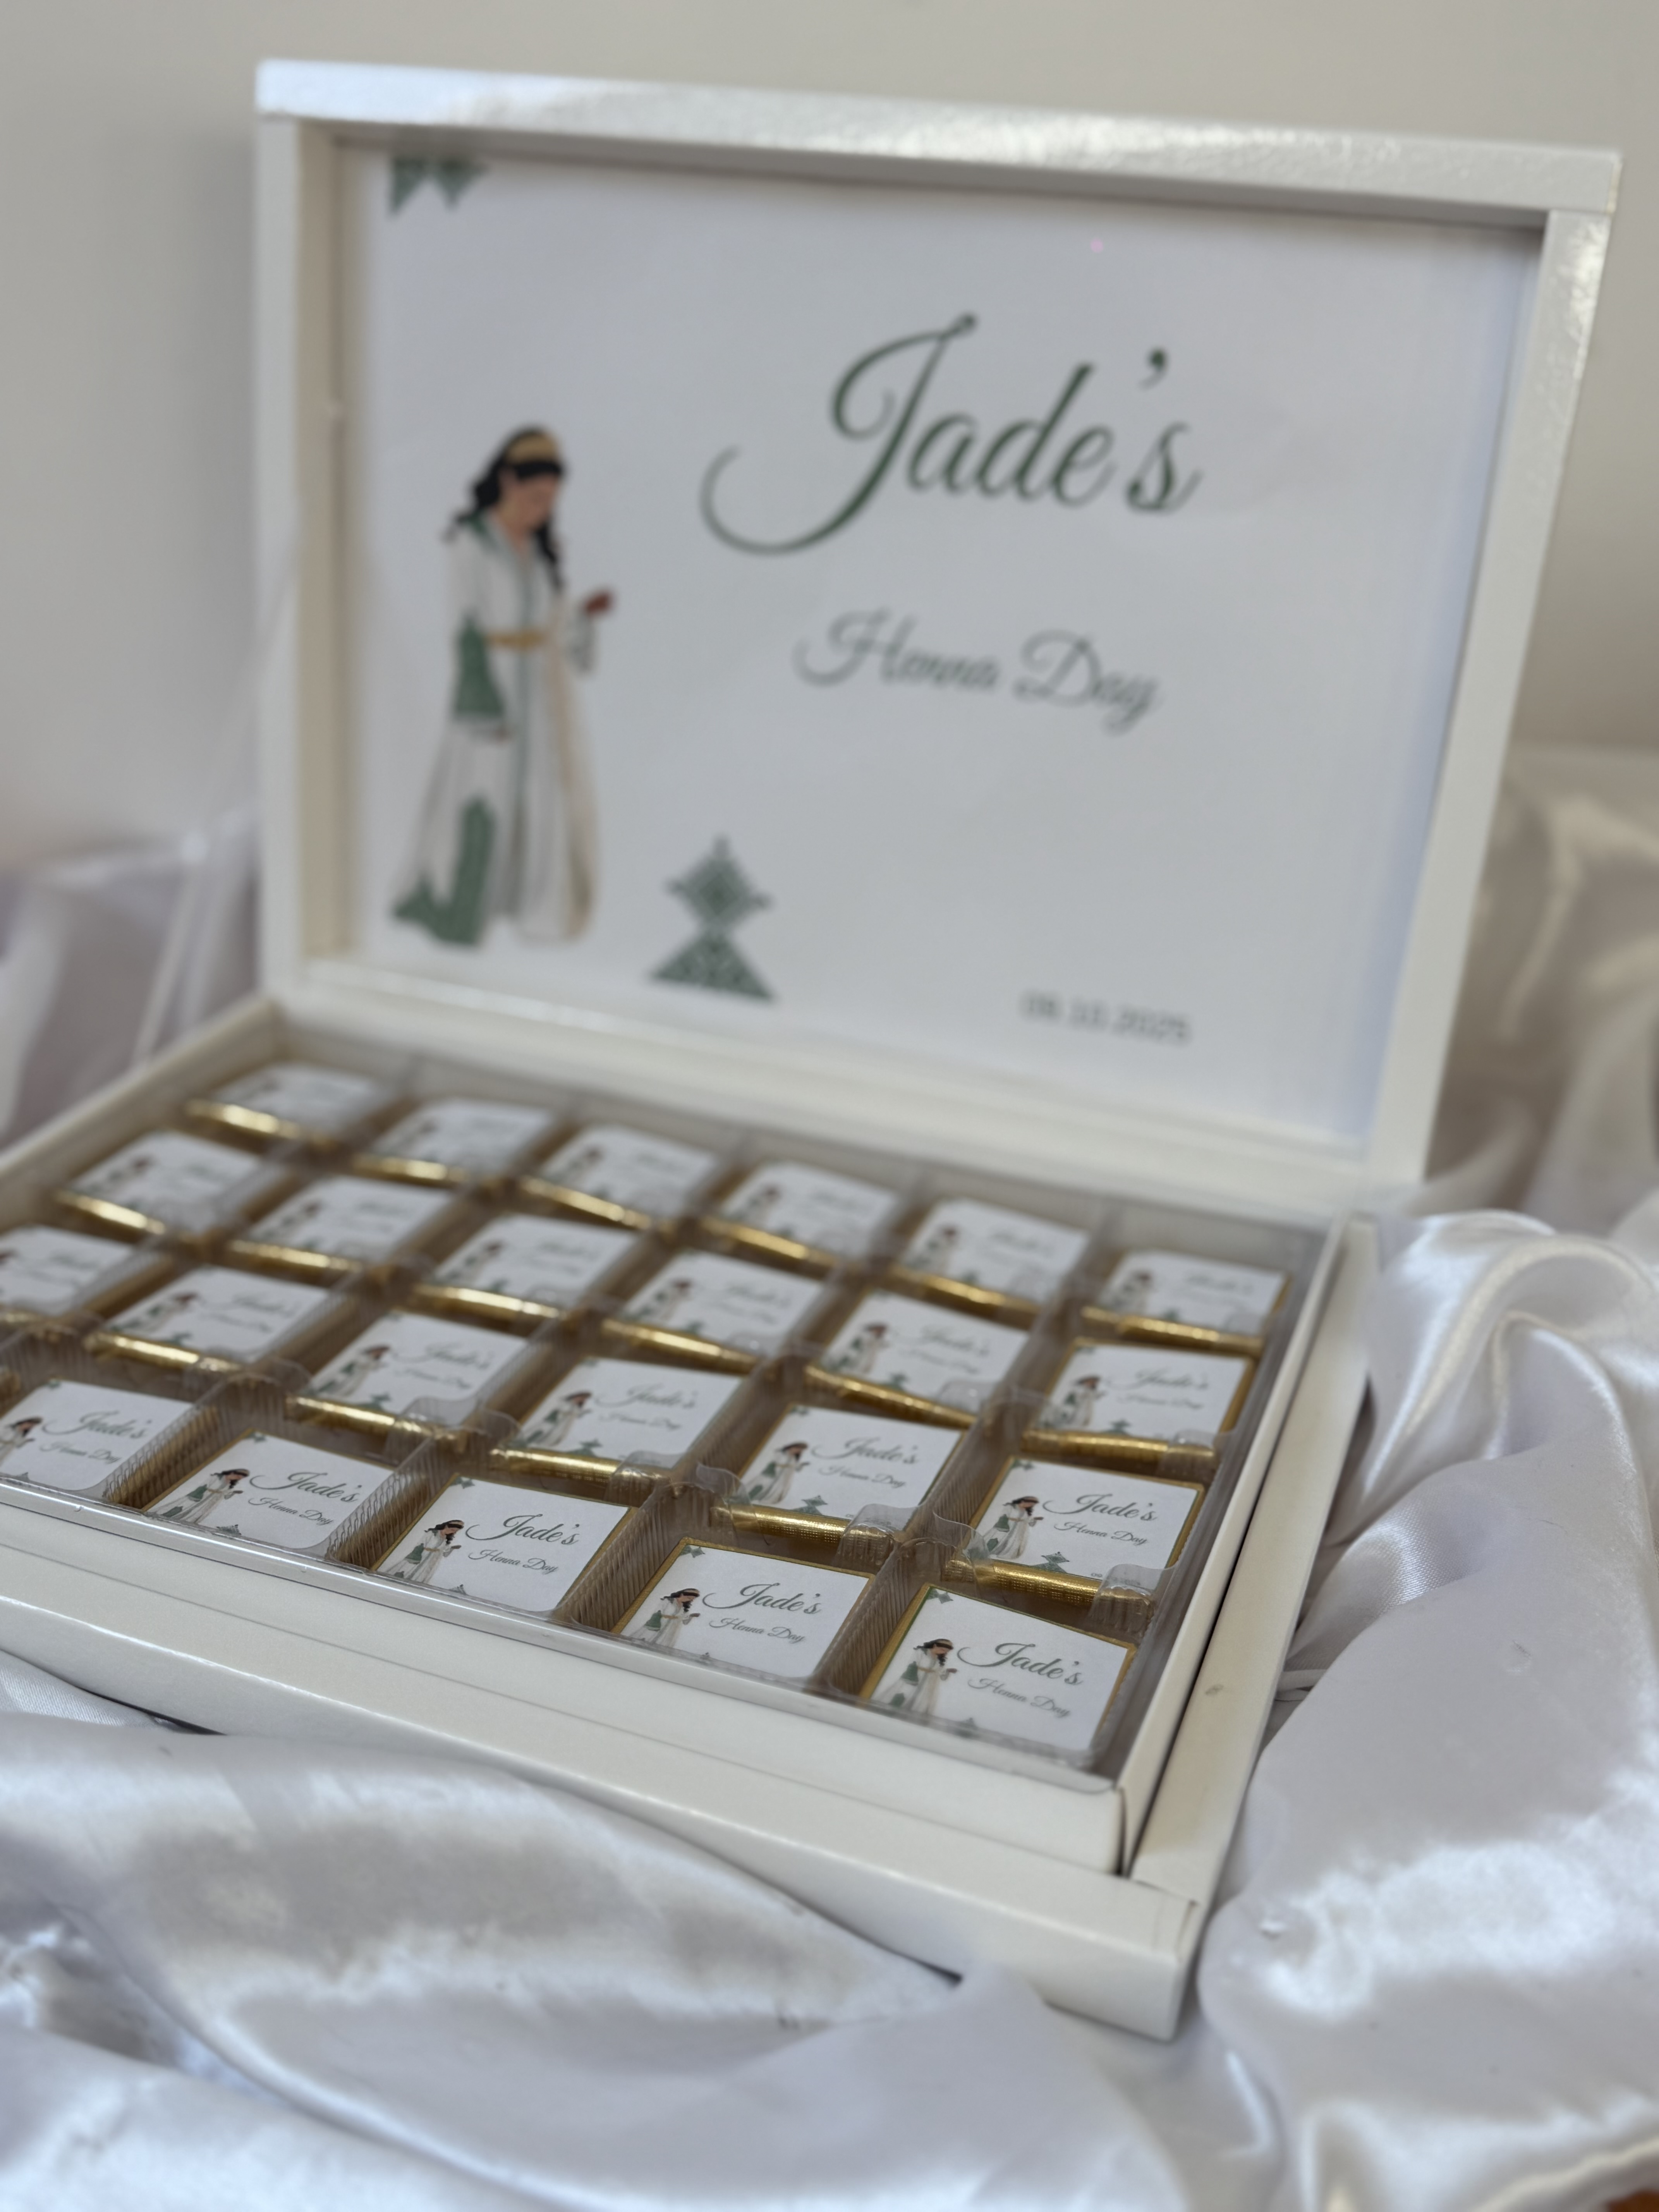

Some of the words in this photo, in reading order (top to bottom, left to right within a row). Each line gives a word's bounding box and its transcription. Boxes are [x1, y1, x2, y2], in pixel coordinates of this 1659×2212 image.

[699, 313, 1204, 557] Jade's
[1012, 627, 1161, 738] Day
[811, 1437, 920, 1464] Jade's
[249, 1471, 361, 1503] Jade's
[248, 1497, 298, 1515] Henna
[299, 1509, 335, 1526] Day
[1042, 1493, 1159, 1522] Jade's
[465, 1513, 582, 1546] Jade's
[1053, 1521, 1108, 1539] Henna
[1110, 1528, 1149, 1546] Day
[468, 1549, 521, 1566] Henna
[523, 1557, 558, 1575] Day
[702, 1582, 822, 1615] Jade's
[709, 1617, 764, 1635] Henna
[766, 1626, 806, 1644] Day
[957, 1642, 1084, 1685] Jade's
[968, 1678, 1028, 1703] Henna
[1030, 1695, 1071, 1719] Day
